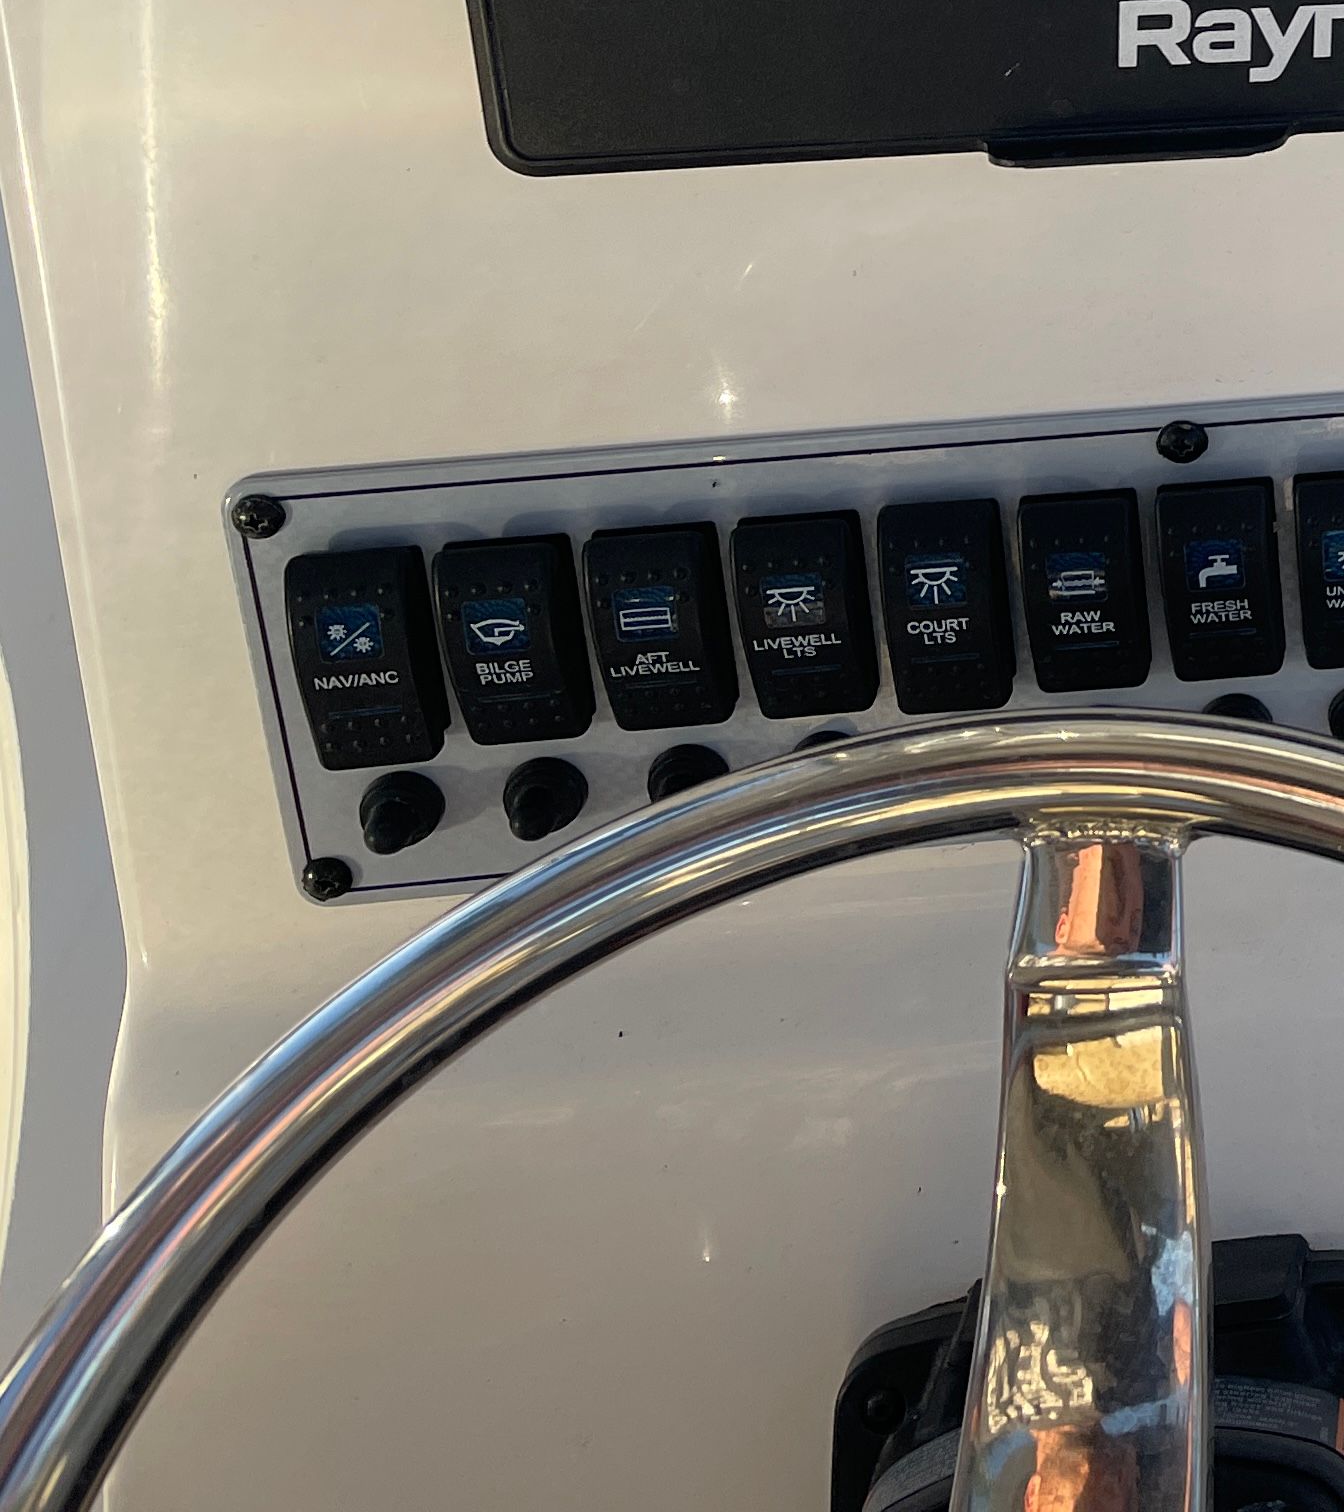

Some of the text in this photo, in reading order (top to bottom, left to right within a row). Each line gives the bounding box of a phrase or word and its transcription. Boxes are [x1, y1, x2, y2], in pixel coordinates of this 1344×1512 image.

[1190, 599, 1250, 614] FRESH
[1060, 609, 1102, 624] RAW
[1190, 609, 1253, 625] WATER
[907, 618, 969, 635] COURT
[1051, 621, 1116, 636] WATER
[753, 633, 843, 651] LIVEWELL
[923, 632, 957, 645] LTS
[635, 651, 670, 665] AFT
[782, 645, 817, 658] LTS
[475, 659, 532, 675] BILGE
[610, 660, 700, 678] LIVEWELL
[314, 670, 399, 691] NAV/ANC
[479, 670, 534, 686] PUMP
